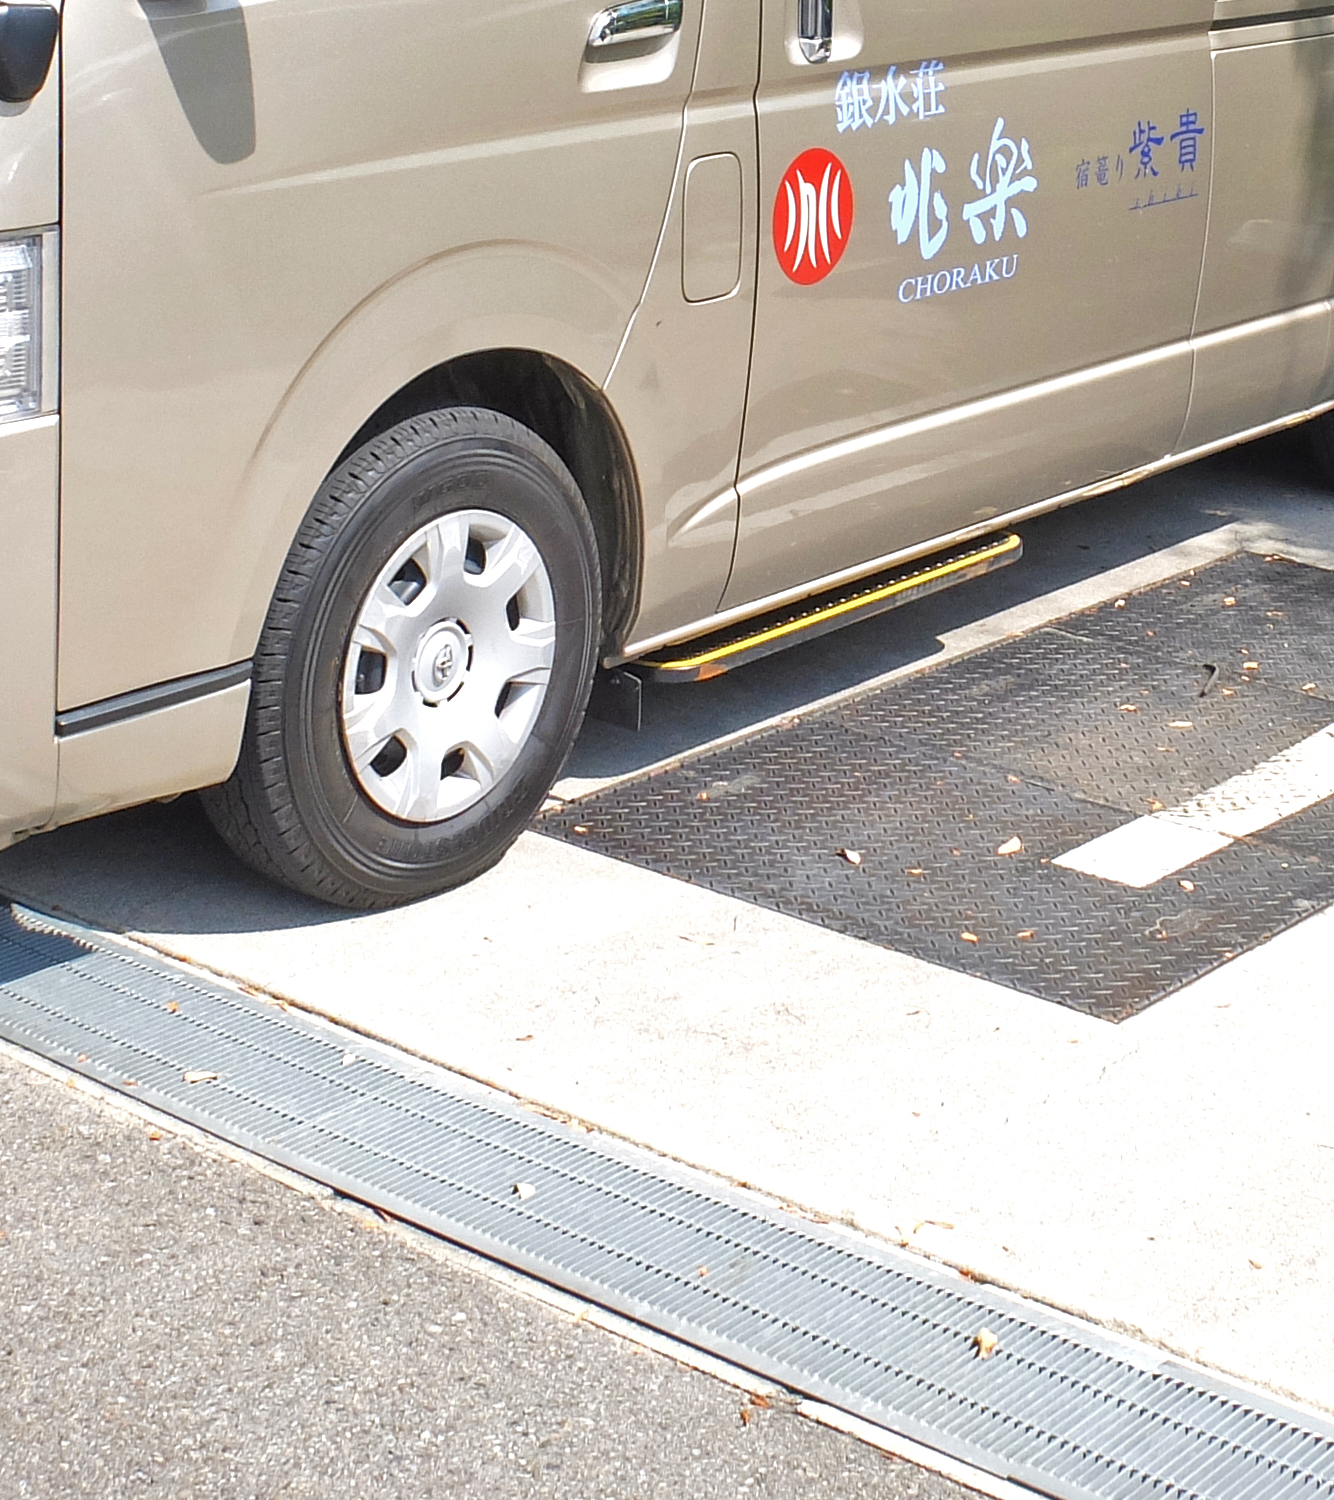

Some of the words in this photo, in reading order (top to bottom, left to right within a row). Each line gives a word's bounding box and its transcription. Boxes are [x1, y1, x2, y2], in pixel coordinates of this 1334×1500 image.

[835, 59, 946, 134] 銀水荘
[1128, 107, 1205, 179] 紫貴
[897, 253, 1019, 304] CHORAKU
